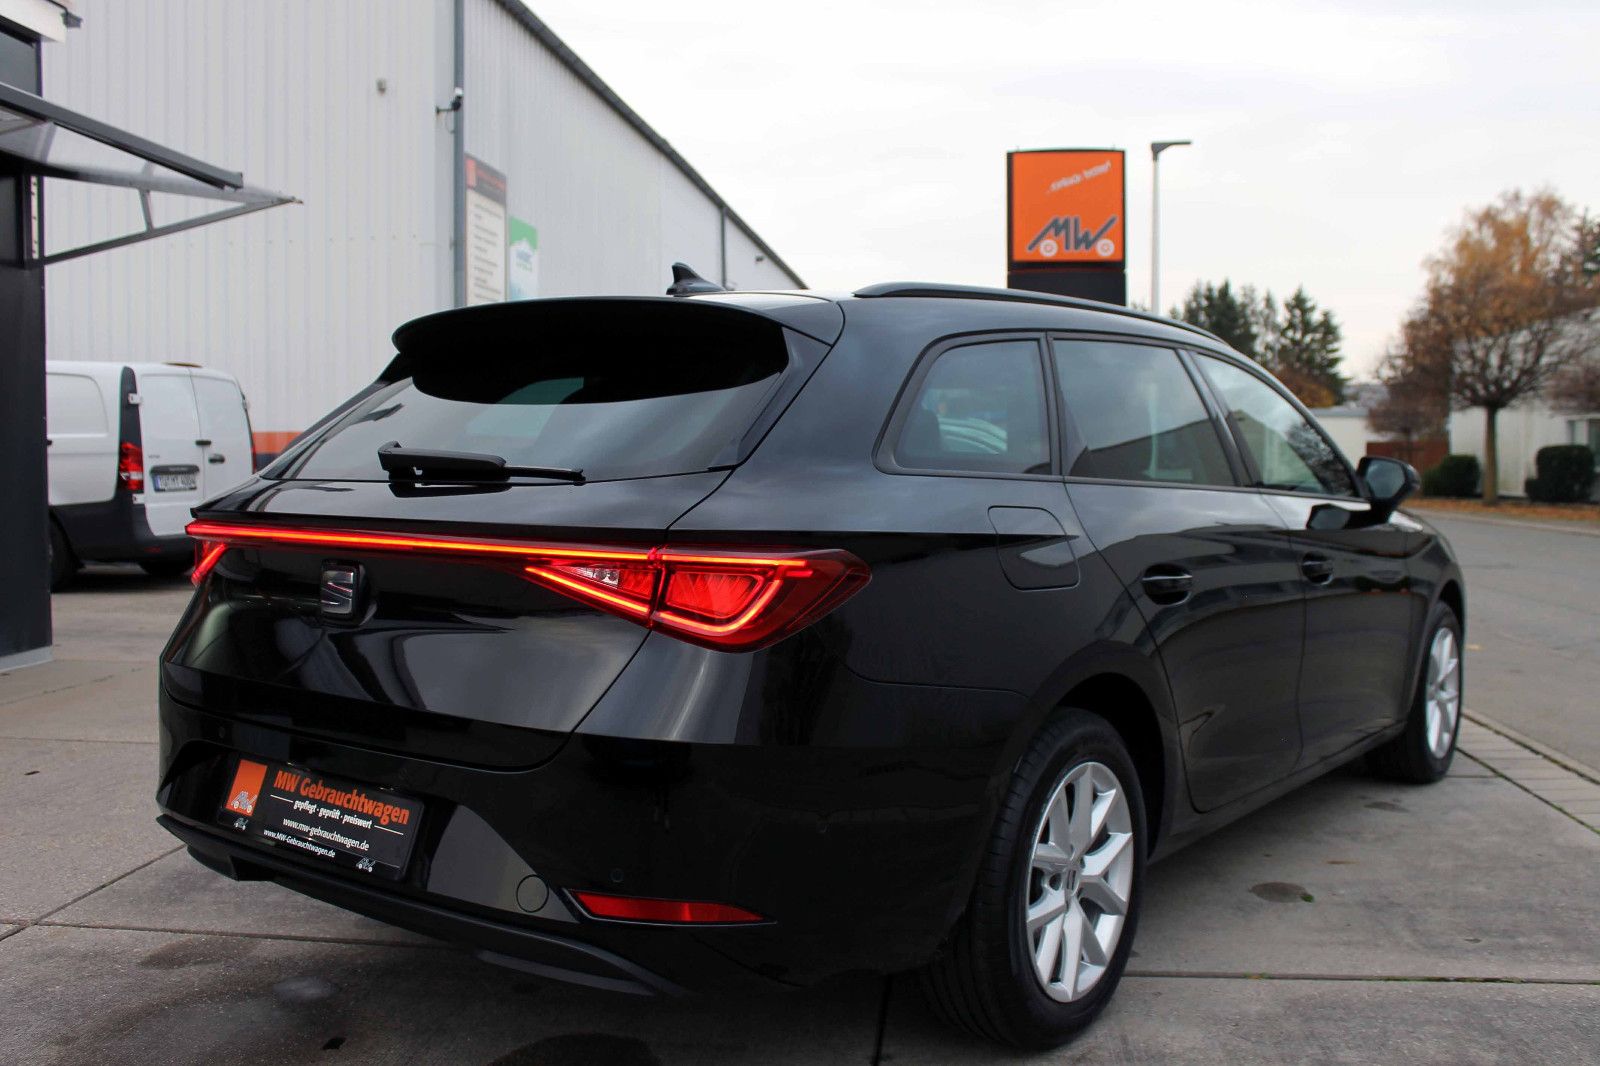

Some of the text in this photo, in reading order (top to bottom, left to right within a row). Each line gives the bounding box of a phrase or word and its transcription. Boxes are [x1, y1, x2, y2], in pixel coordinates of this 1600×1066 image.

[1027, 215, 1118, 254] MW
[273, 770, 410, 825] MW Gebrauchtwagen
[293, 799, 373, 829] gepflegt geprüft preiswert
[263, 828, 336, 858] www.MW-Gebrauchtwagen.de
[282, 817, 370, 851] www.mw-gebrauchtwagen.de
